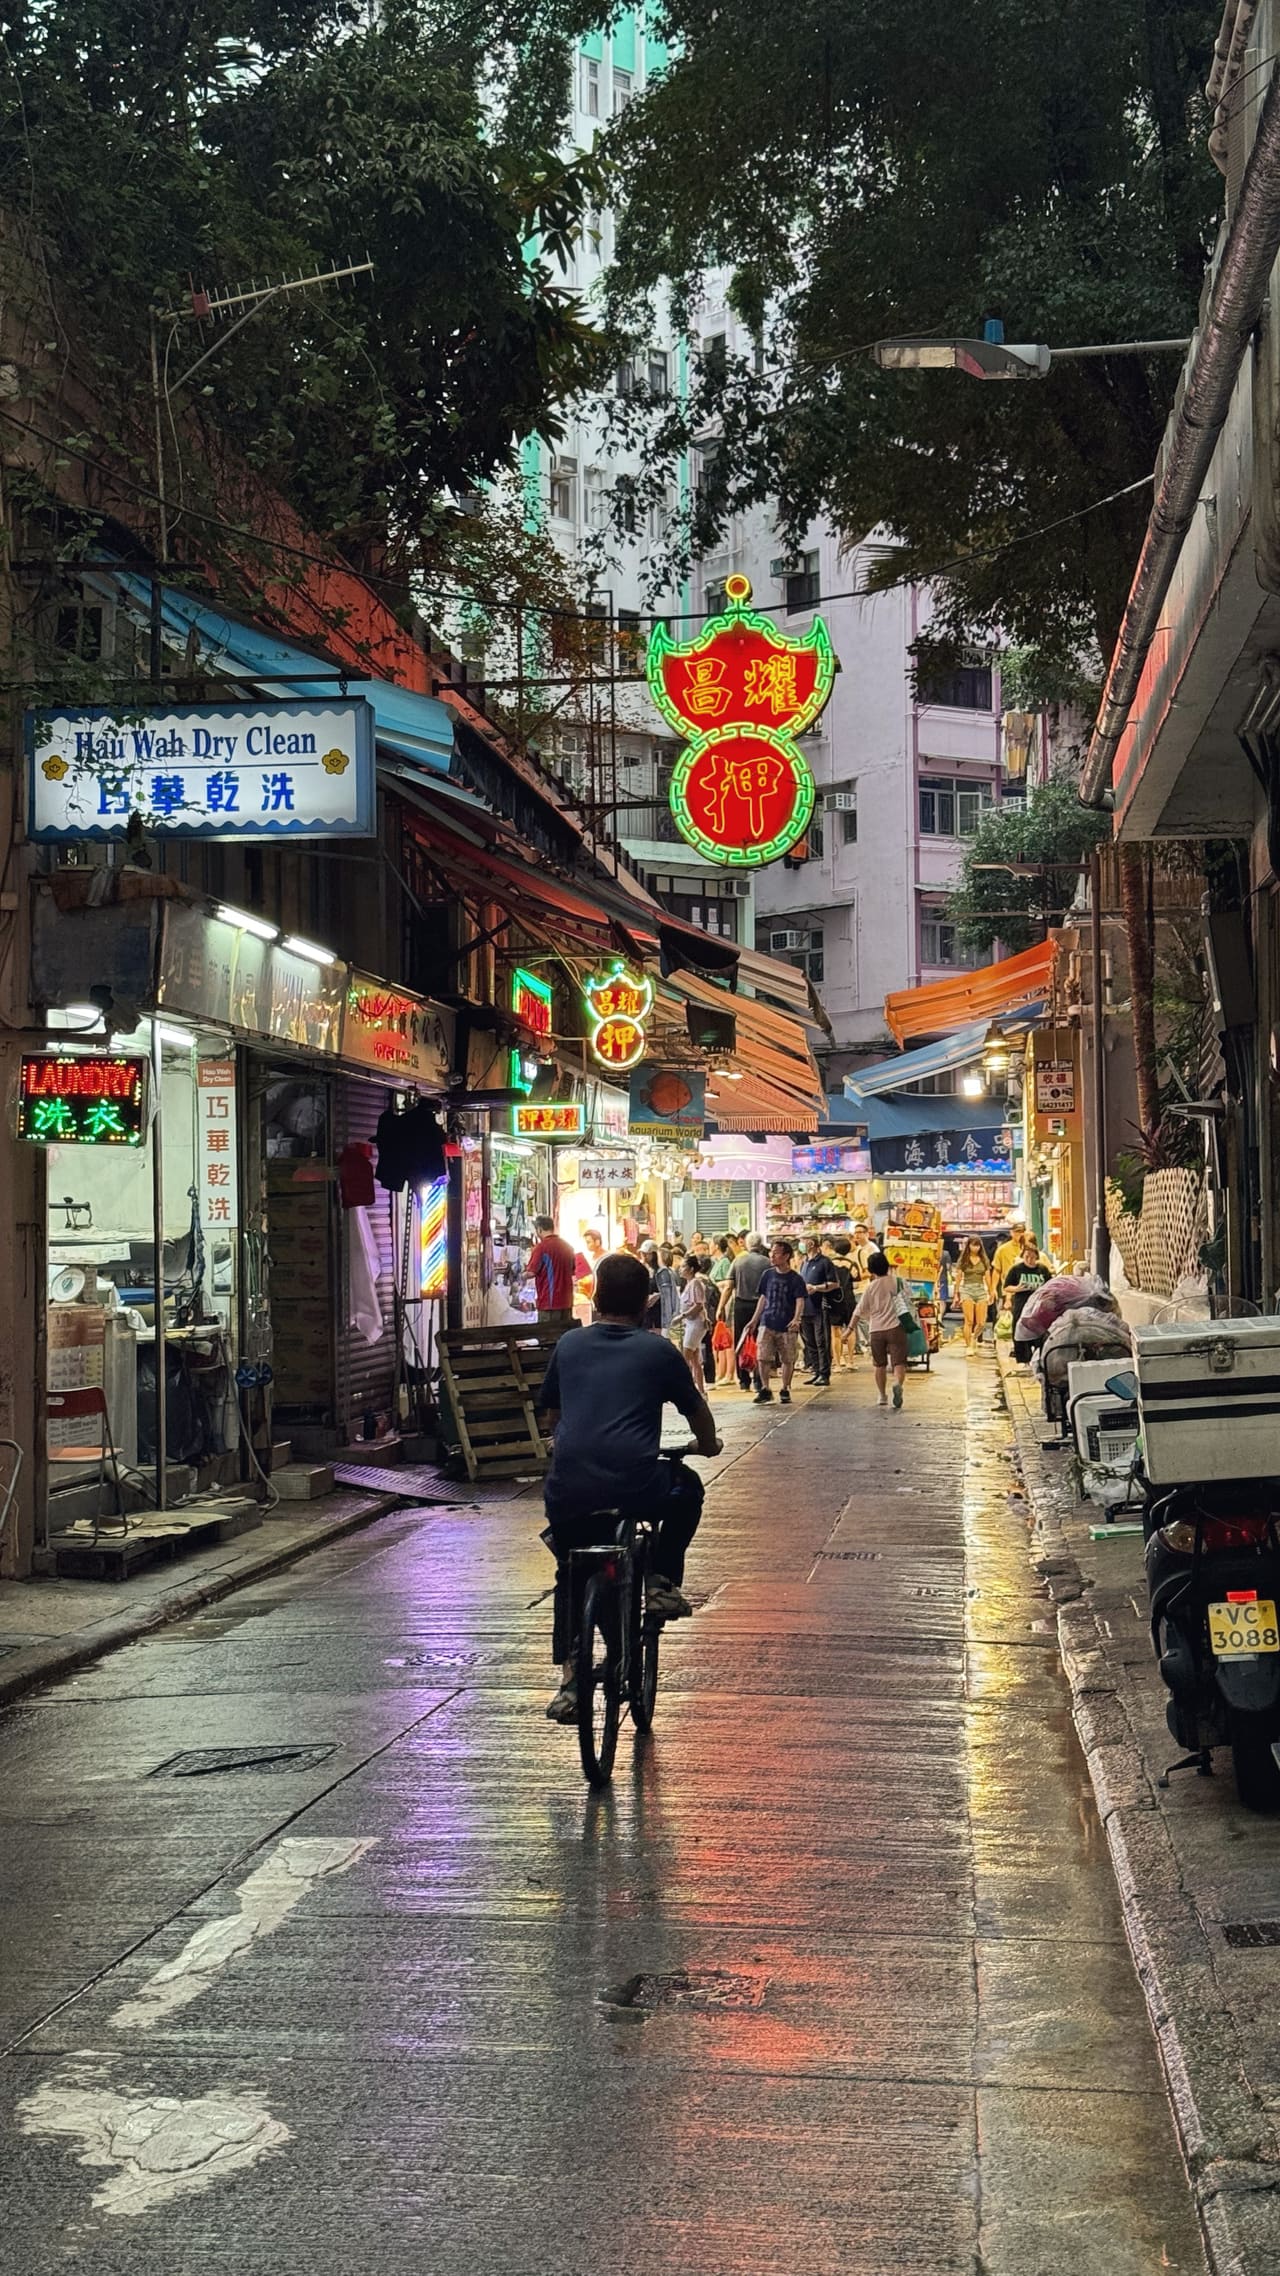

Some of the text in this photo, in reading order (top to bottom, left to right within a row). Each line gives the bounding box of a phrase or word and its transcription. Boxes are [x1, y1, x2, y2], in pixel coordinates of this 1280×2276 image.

[75, 725, 317, 762] Hau Wah Dry Clean
[699, 755, 784, 839] 押
[602, 1023, 636, 1060] 押
[28, 1064, 137, 1096] LAUNDRY
[34, 1097, 124, 1134] 洗衣
[630, 1126, 702, 1137] Aquarium World
[206, 1096, 231, 1220] 巧華乾洗
[1226, 1606, 1258, 1625] VC
[1213, 1628, 1278, 1649] 3088
